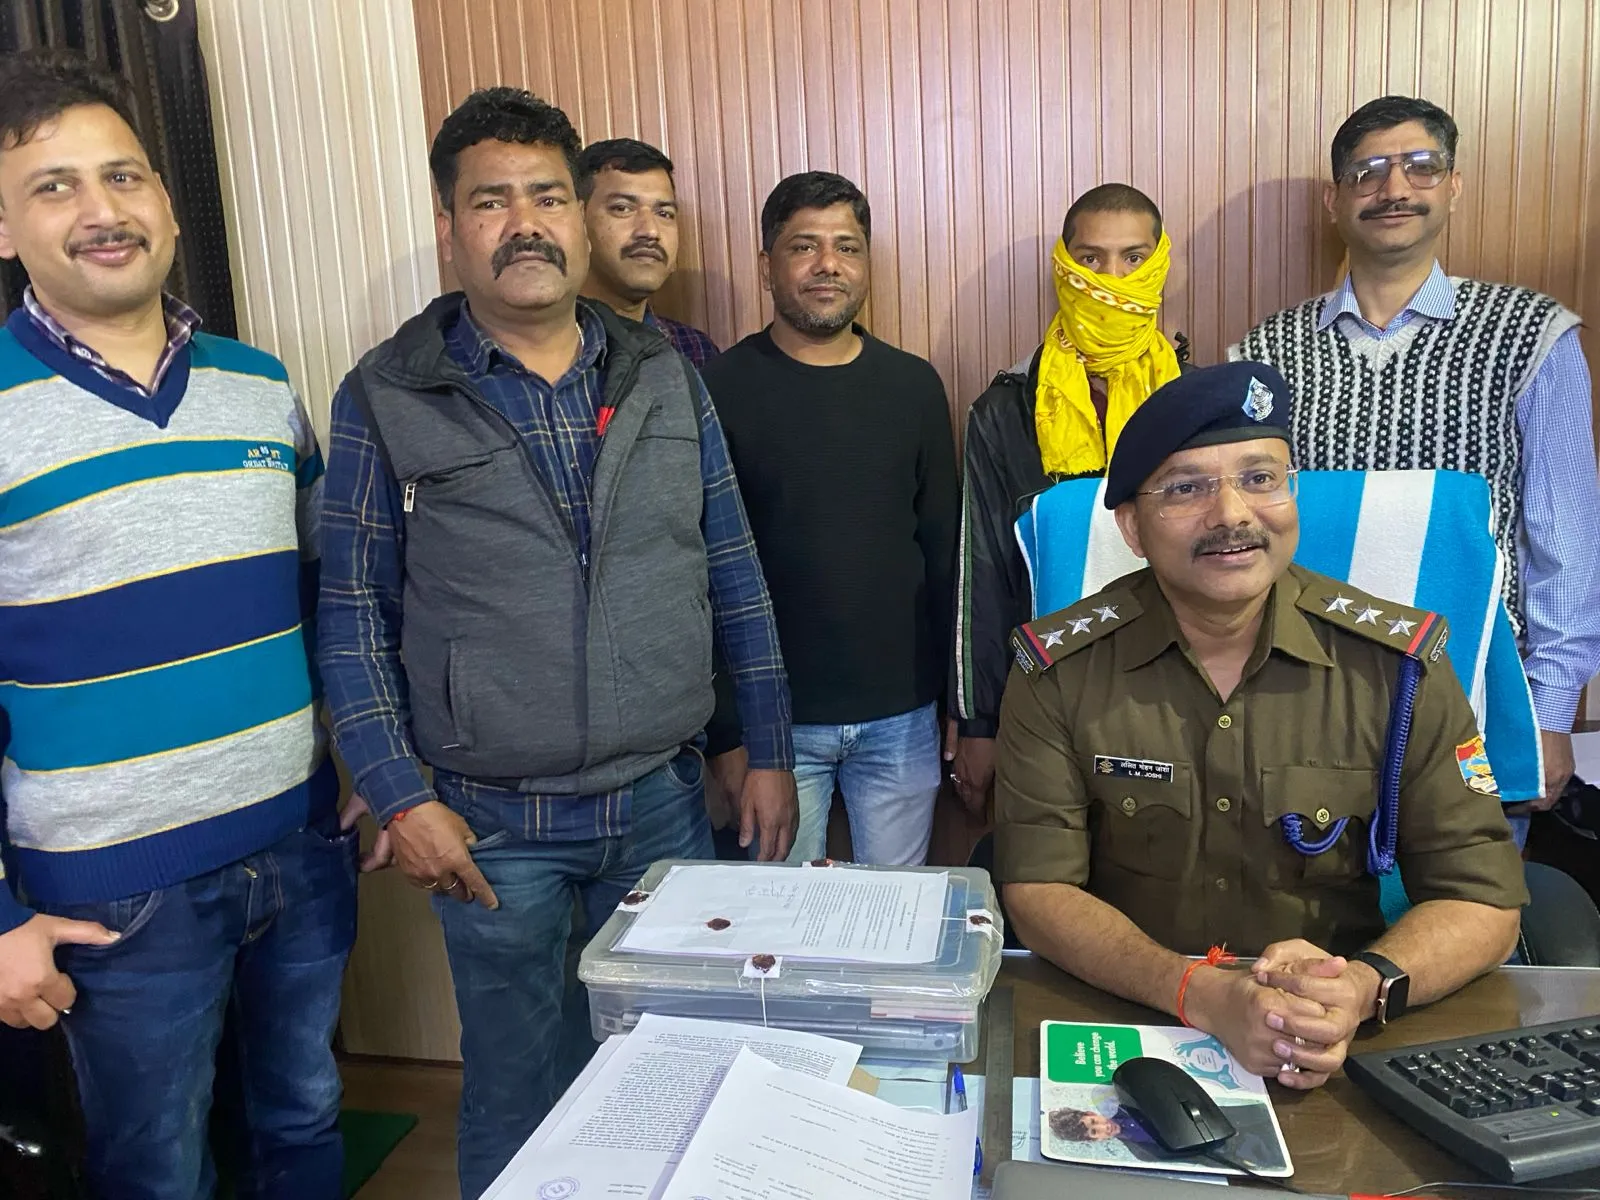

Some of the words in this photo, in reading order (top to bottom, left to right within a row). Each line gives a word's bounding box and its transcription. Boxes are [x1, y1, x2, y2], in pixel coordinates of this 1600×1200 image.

[1120, 761, 1137, 769] ललित
[1090, 1032, 1103, 1054] change
[1074, 1041, 1086, 1065] Believe
[1104, 1040, 1117, 1059] world.
[1093, 1055, 1102, 1065] can
[1106, 1059, 1118, 1070] the
[1094, 1066, 1105, 1078] you
